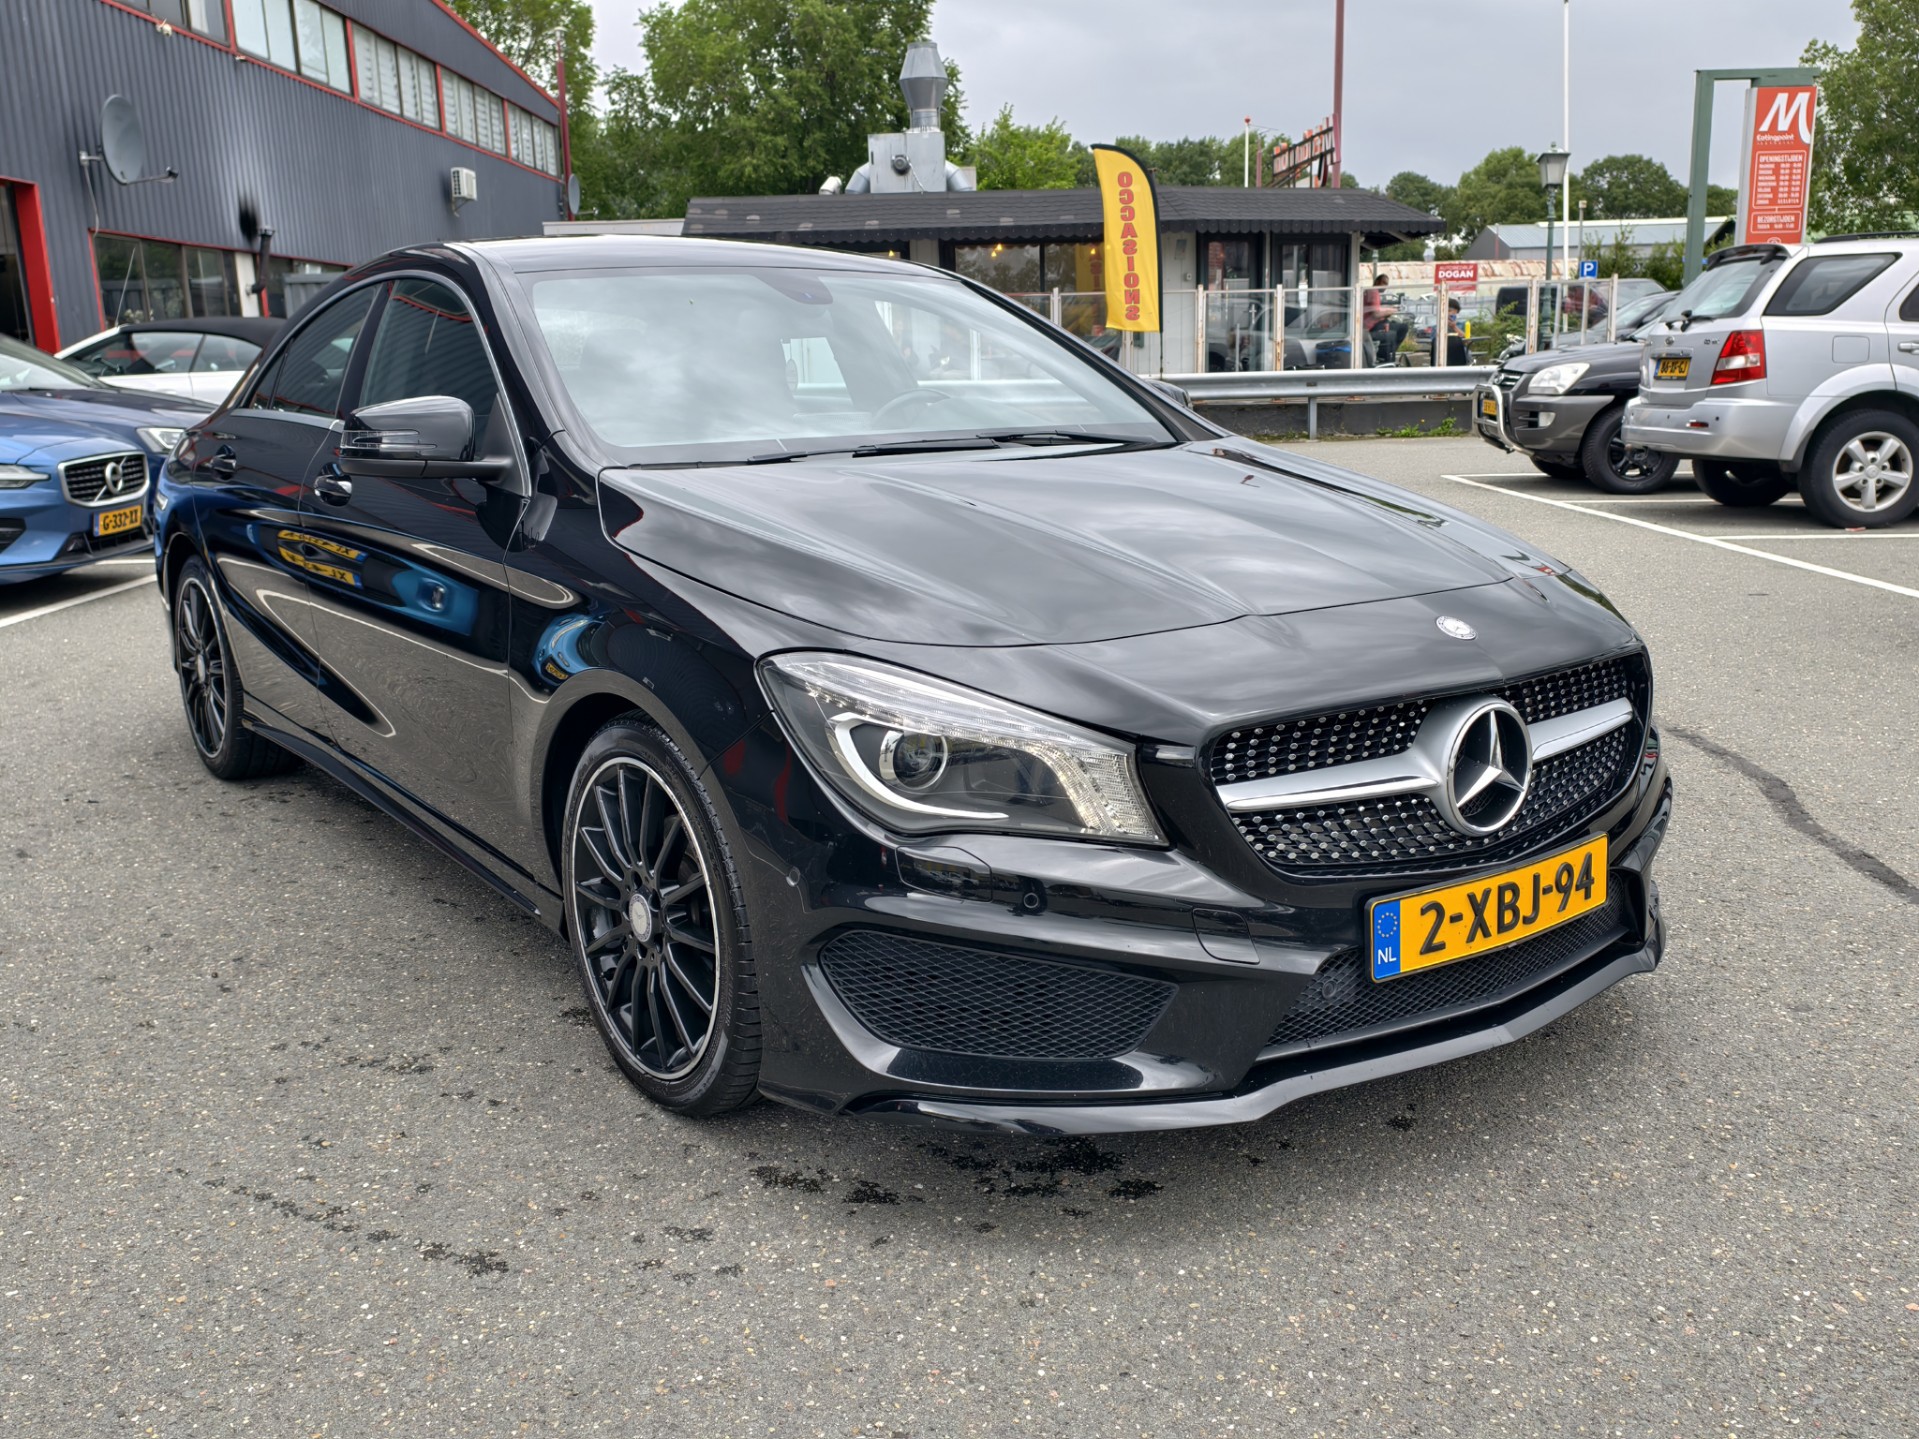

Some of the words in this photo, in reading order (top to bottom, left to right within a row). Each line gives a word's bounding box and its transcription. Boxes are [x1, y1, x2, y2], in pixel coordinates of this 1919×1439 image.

[1759, 92, 1811, 144] M
[1438, 270, 1474, 278] DOGAN
[1583, 262, 1594, 276] P
[1419, 851, 1595, 956] 2-XBJ-94
[1377, 946, 1397, 965] NL
